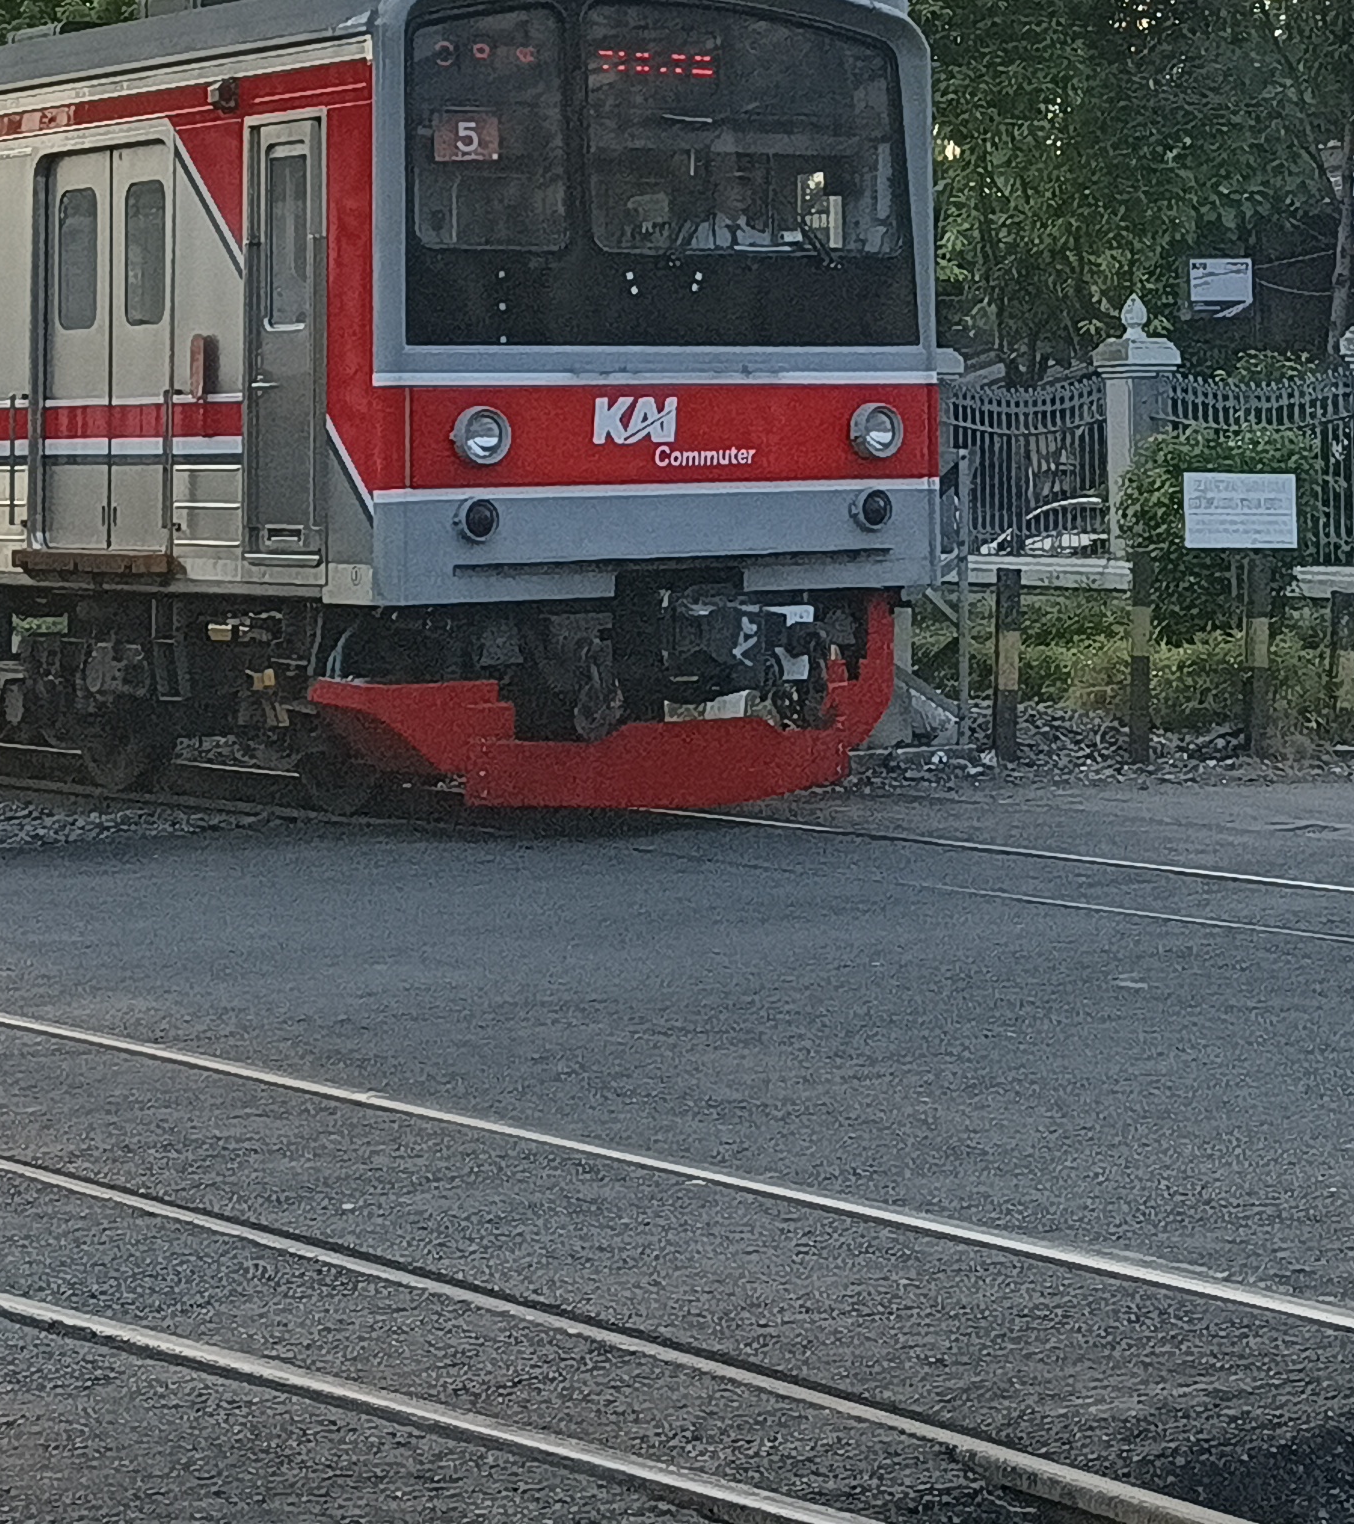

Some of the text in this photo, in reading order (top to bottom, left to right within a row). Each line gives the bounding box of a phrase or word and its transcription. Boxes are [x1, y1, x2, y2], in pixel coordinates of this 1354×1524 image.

[455, 120, 479, 153] 5
[592, 396, 678, 445] KAI
[654, 445, 757, 467] Commuter
